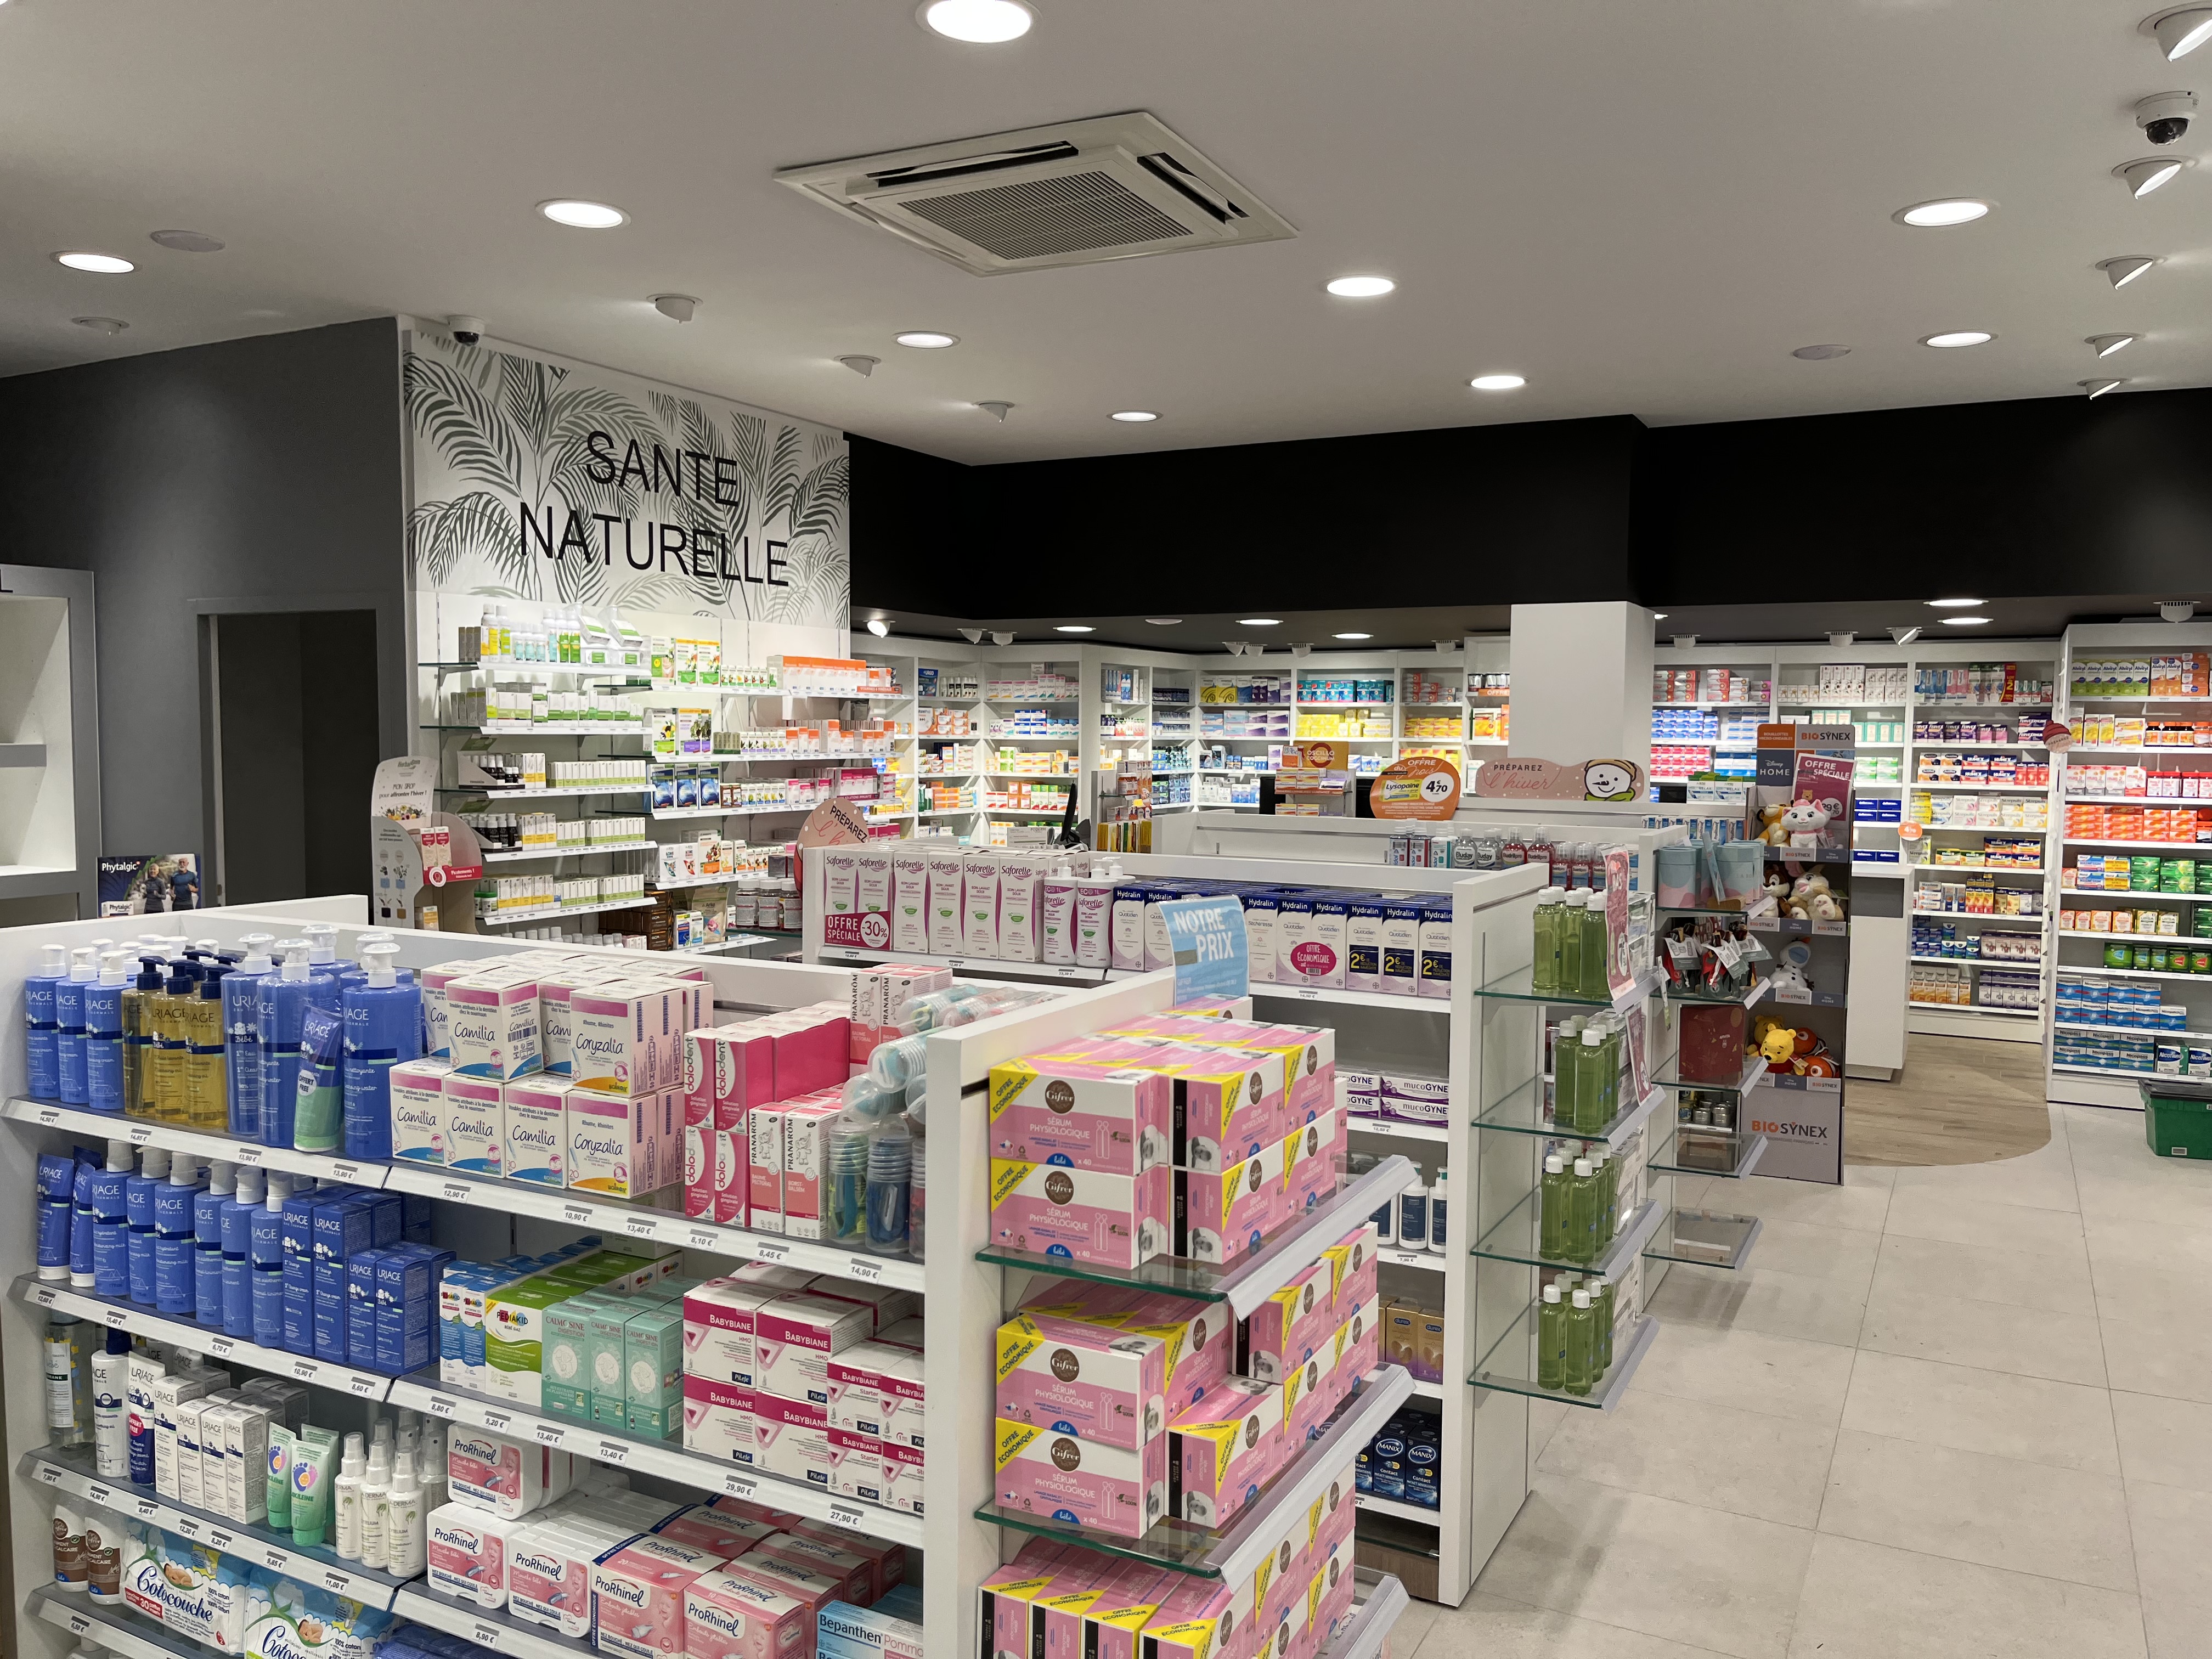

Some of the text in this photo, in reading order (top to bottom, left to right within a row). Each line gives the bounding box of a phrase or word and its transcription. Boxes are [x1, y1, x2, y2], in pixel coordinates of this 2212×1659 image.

[586, 431, 738, 507] SANTE
[520, 502, 789, 587] NATURELLE
[1493, 763, 1542, 771] PRÉPAREZ
[1805, 760, 1837, 770] OFFRE
[1426, 781, 1435, 792] 4
[101, 862, 137, 872] Phytalgic
[826, 856, 855, 866] Saforelle
[859, 857, 887, 868] Saforelle
[895, 859, 924, 871] Saforelle
[930, 861, 960, 872] Saforelle
[966, 864, 995, 874] Saforelle
[1001, 865, 1031, 876] Saforelle
[1117, 890, 1141, 898] Hydralin
[1149, 892, 1172, 901] Hydralin
[1249, 898, 1274, 907] Hydralin
[1282, 900, 1308, 910] Hydralin
[1317, 902, 1342, 912] Hydralin
[1352, 905, 1379, 915] Hydralin
[828, 916, 888, 938] OFFRE -30%
[1173, 908, 1226, 934] NOTRE
[827, 928, 860, 941] SPÉCIALE
[1195, 931, 1234, 963] PRIX
[1306, 944, 1321, 953] OFFRE
[1351, 953, 1359, 969] 2
[1385, 956, 1394, 972] 2
[454, 1022, 495, 1041] Camilia
[576, 1034, 624, 1055] Coryzalia
[684, 1037, 694, 1092] dolodent
[716, 1041, 726, 1096] dolodent
[299, 1075, 314, 1086] OFFERT
[299, 1082, 309, 1093] FREE
[996, 1077, 1014, 1097] OFFRE
[1404, 1081, 1448, 1093] mucoGYNE
[992, 1075, 1029, 1114] ECONOMIQUE
[1046, 1090, 1075, 1103] Gifrer
[397, 1107, 437, 1126] Camilia
[1047, 1116, 1072, 1128] SÉRUM
[452, 1116, 494, 1137] Camilia
[1030, 1122, 1090, 1139] PHYSIOLOGIQUE
[512, 1125, 556, 1147] Camilia
[574, 1135, 624, 1155] Coryzalia
[994, 1165, 1029, 1203] ECONOMIQUE
[997, 1167, 1014, 1187] OFFRE
[444, 1189, 460, 1198] 12,90
[1045, 1181, 1074, 1194] Gifrer
[283, 1211, 308, 1226] URIAGE
[1047, 1208, 1071, 1220] SÉRUM
[315, 1217, 340, 1232] URIAGE
[627, 1224, 645, 1234] 13,40
[1029, 1214, 1088, 1231] PHYSIOLOGIQUE
[691, 1236, 707, 1246] 8,10
[851, 1266, 871, 1277] 14,90
[496, 1310, 528, 1326] PEDIAKID
[709, 1314, 752, 1331] BABYBIANE
[557, 1327, 585, 1338] DIGESTION
[786, 1330, 828, 1349] BABYBIANE
[999, 1340, 1035, 1375] ECONOMIQUE
[1002, 1341, 1019, 1360] OFFRE
[1051, 1357, 1079, 1371] Gifrer
[842, 1372, 878, 1387] BABYBIANE
[860, 1388, 879, 1397] Starter
[1035, 1389, 1094, 1409] PHYSIOLOGIQUE
[537, 1431, 553, 1442] 13,40
[454, 1438, 496, 1465] ProRhinel
[1379, 1442, 1400, 1453] MANIX
[1380, 1468, 1398, 1476] Contact
[725, 1482, 745, 1494] 29,90
[830, 1511, 851, 1523] 27,90
[434, 1527, 478, 1554] ProRhinel
[516, 1552, 562, 1581] ProRhinel
[137, 1566, 214, 1622] Cotocouche
[595, 1575, 644, 1608] ProRhinel
[140, 1599, 150, 1611] 30
[689, 1602, 739, 1637] ProRhinel
[820, 1614, 882, 1644] Bepanthen
